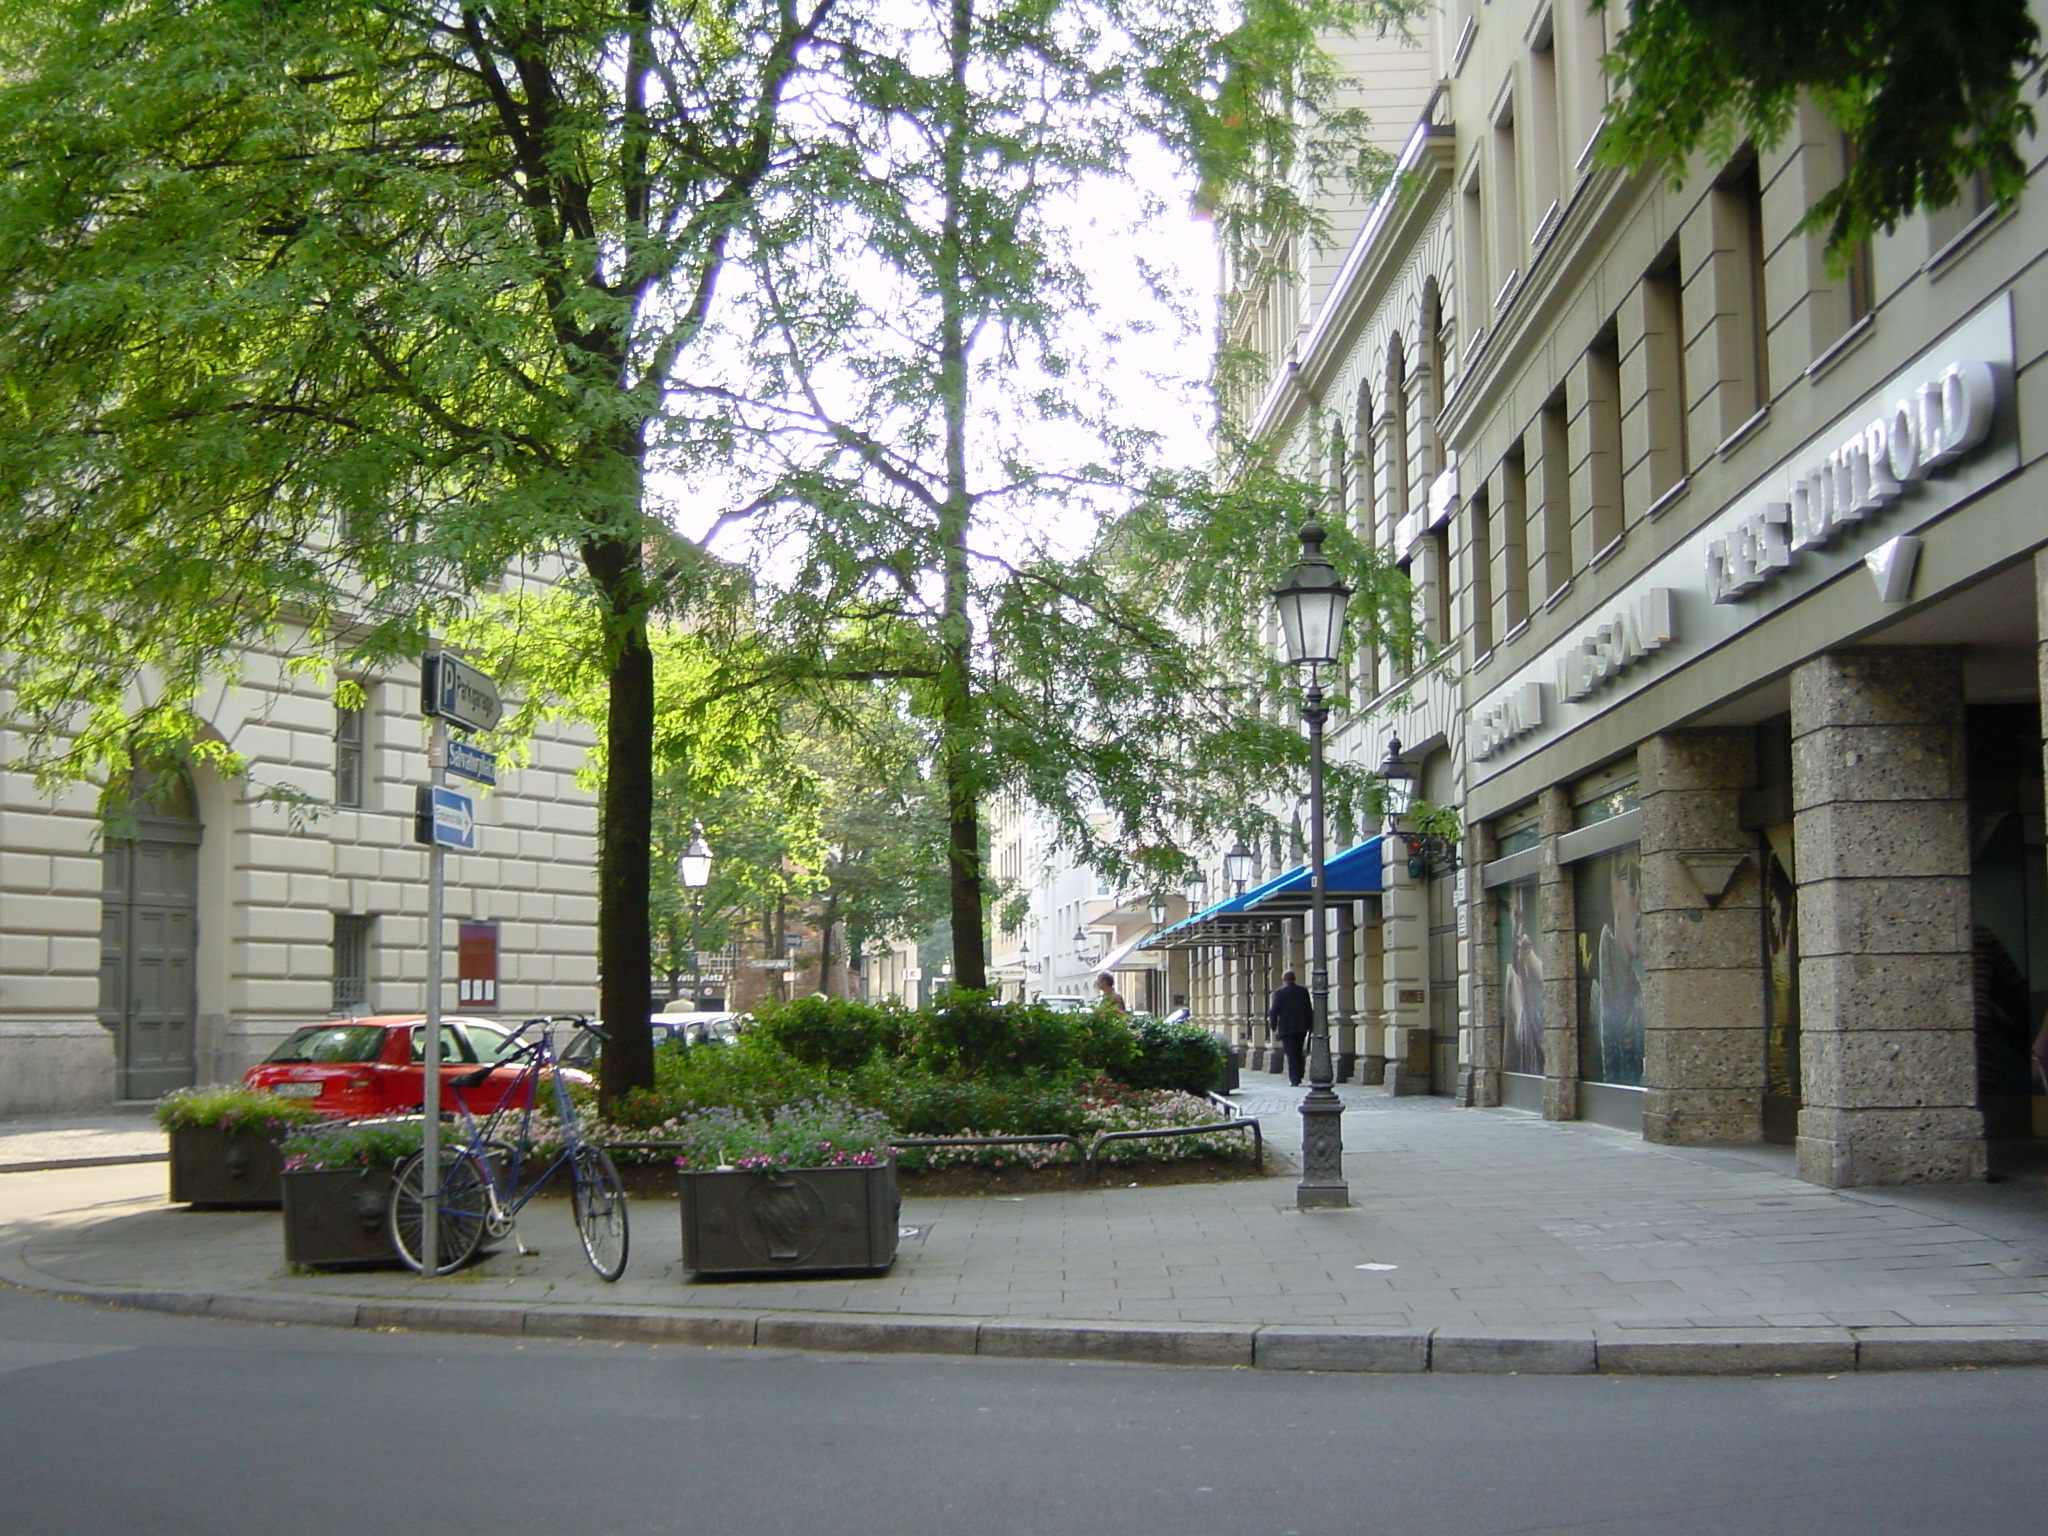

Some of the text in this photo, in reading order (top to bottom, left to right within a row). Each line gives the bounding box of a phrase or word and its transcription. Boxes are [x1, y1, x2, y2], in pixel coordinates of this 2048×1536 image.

[1790, 361, 1995, 553] LUITPOLD
[444, 662, 454, 705] P
[1556, 586, 1676, 704] MISSONI
